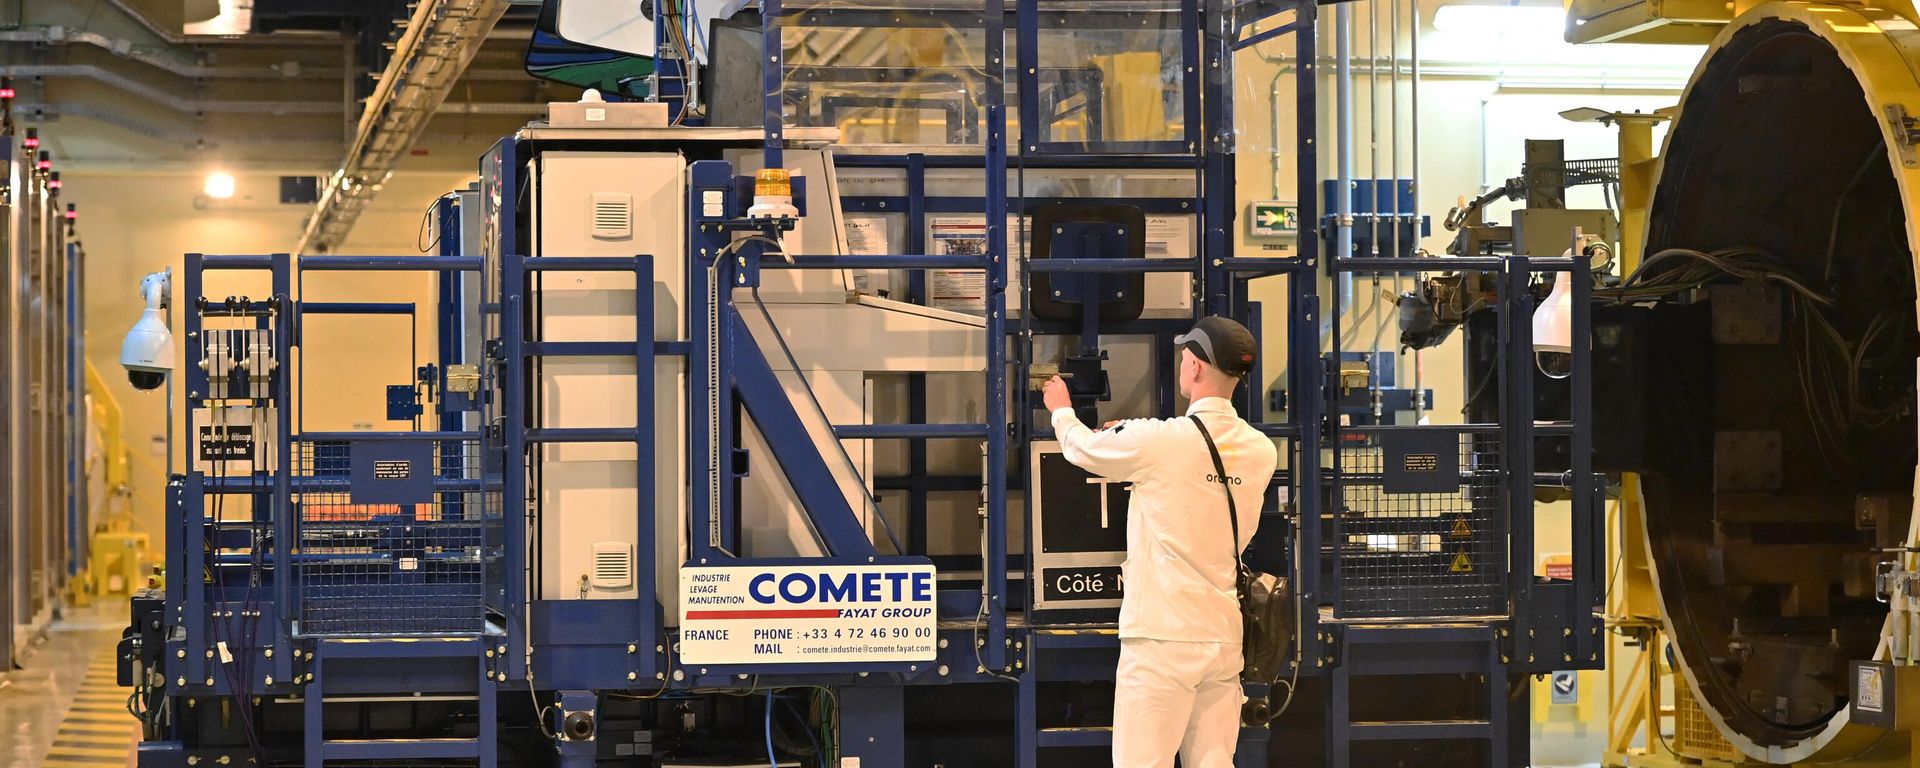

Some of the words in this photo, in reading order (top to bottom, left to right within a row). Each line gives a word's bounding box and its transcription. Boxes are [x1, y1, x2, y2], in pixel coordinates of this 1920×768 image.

[201, 433, 222, 441] Comnde
[206, 446, 222, 455] mauel
[692, 573, 731, 583] INDUSTRIE
[748, 572, 932, 605] COMETE
[1056, 573, 1104, 594] Côté
[690, 585, 718, 594] LEVAGE
[688, 595, 745, 605] MANUTENTION
[837, 608, 877, 618] FAYAT
[882, 608, 932, 618] GROUP
[684, 629, 729, 641] FRANCE
[754, 629, 793, 640] PHONE
[803, 629, 828, 639] +33
[834, 629, 842, 638] 4
[849, 628, 864, 639] 72
[870, 628, 887, 638] 46
[892, 628, 909, 638] 90
[915, 628, 931, 638] 00
[754, 643, 783, 654] MAIL
[802, 645, 931, 655] comete.industrie@comete.fayat.com
